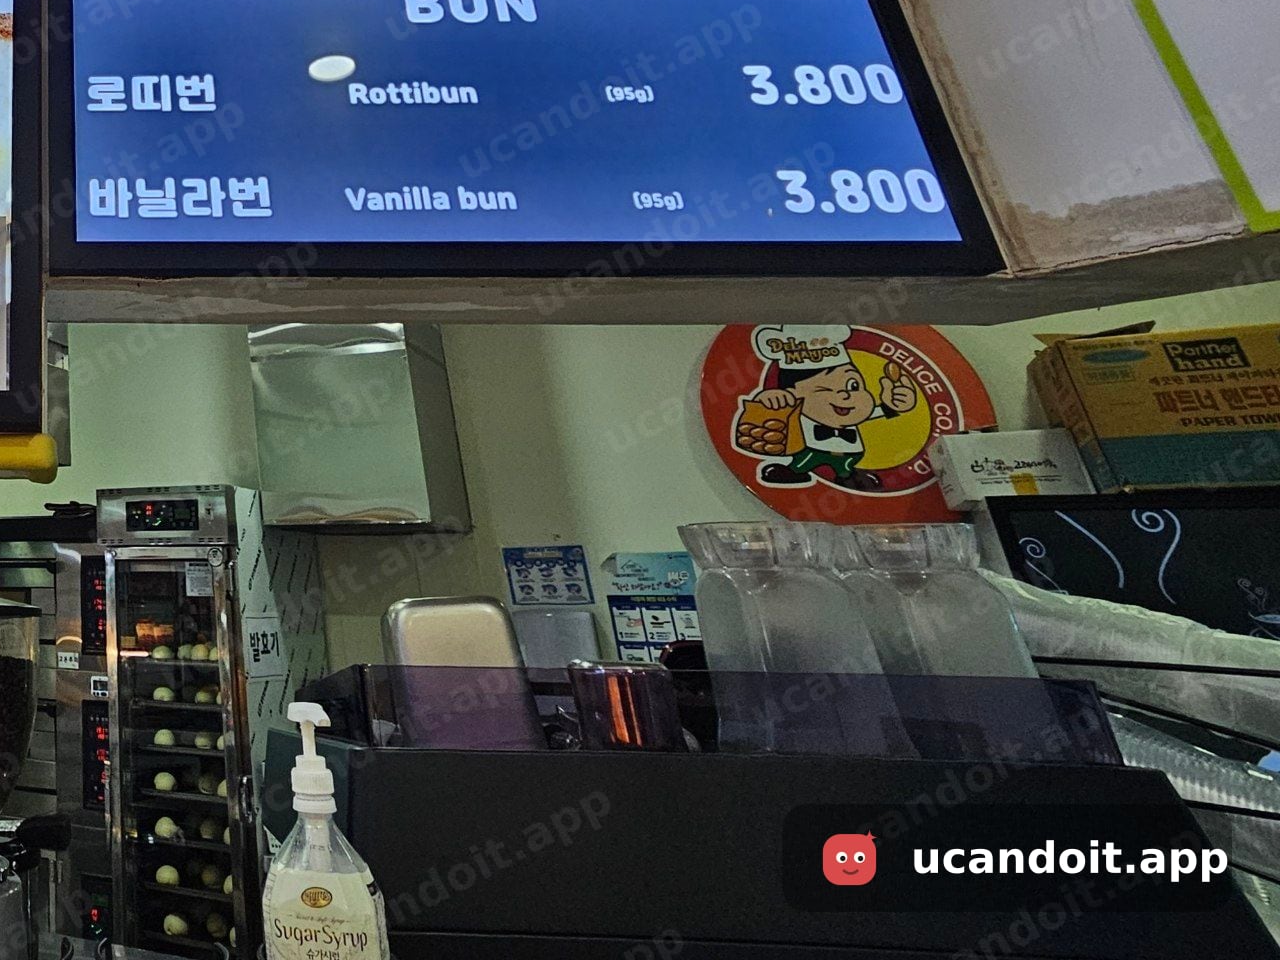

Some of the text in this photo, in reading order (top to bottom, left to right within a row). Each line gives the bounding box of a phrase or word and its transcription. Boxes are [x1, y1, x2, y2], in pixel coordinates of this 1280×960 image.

[87, 64, 904, 112] 로띠번 Rottibun (95g) 3.800
[89, 169, 946, 218] 바닐라번 Vanilla bun (95g) 3.800
[878, 342, 943, 396] DELICE
[1174, 354, 1245, 370] hand
[1179, 415, 1238, 427] PAPER
[274, 918, 368, 952] Sugar Syrup
